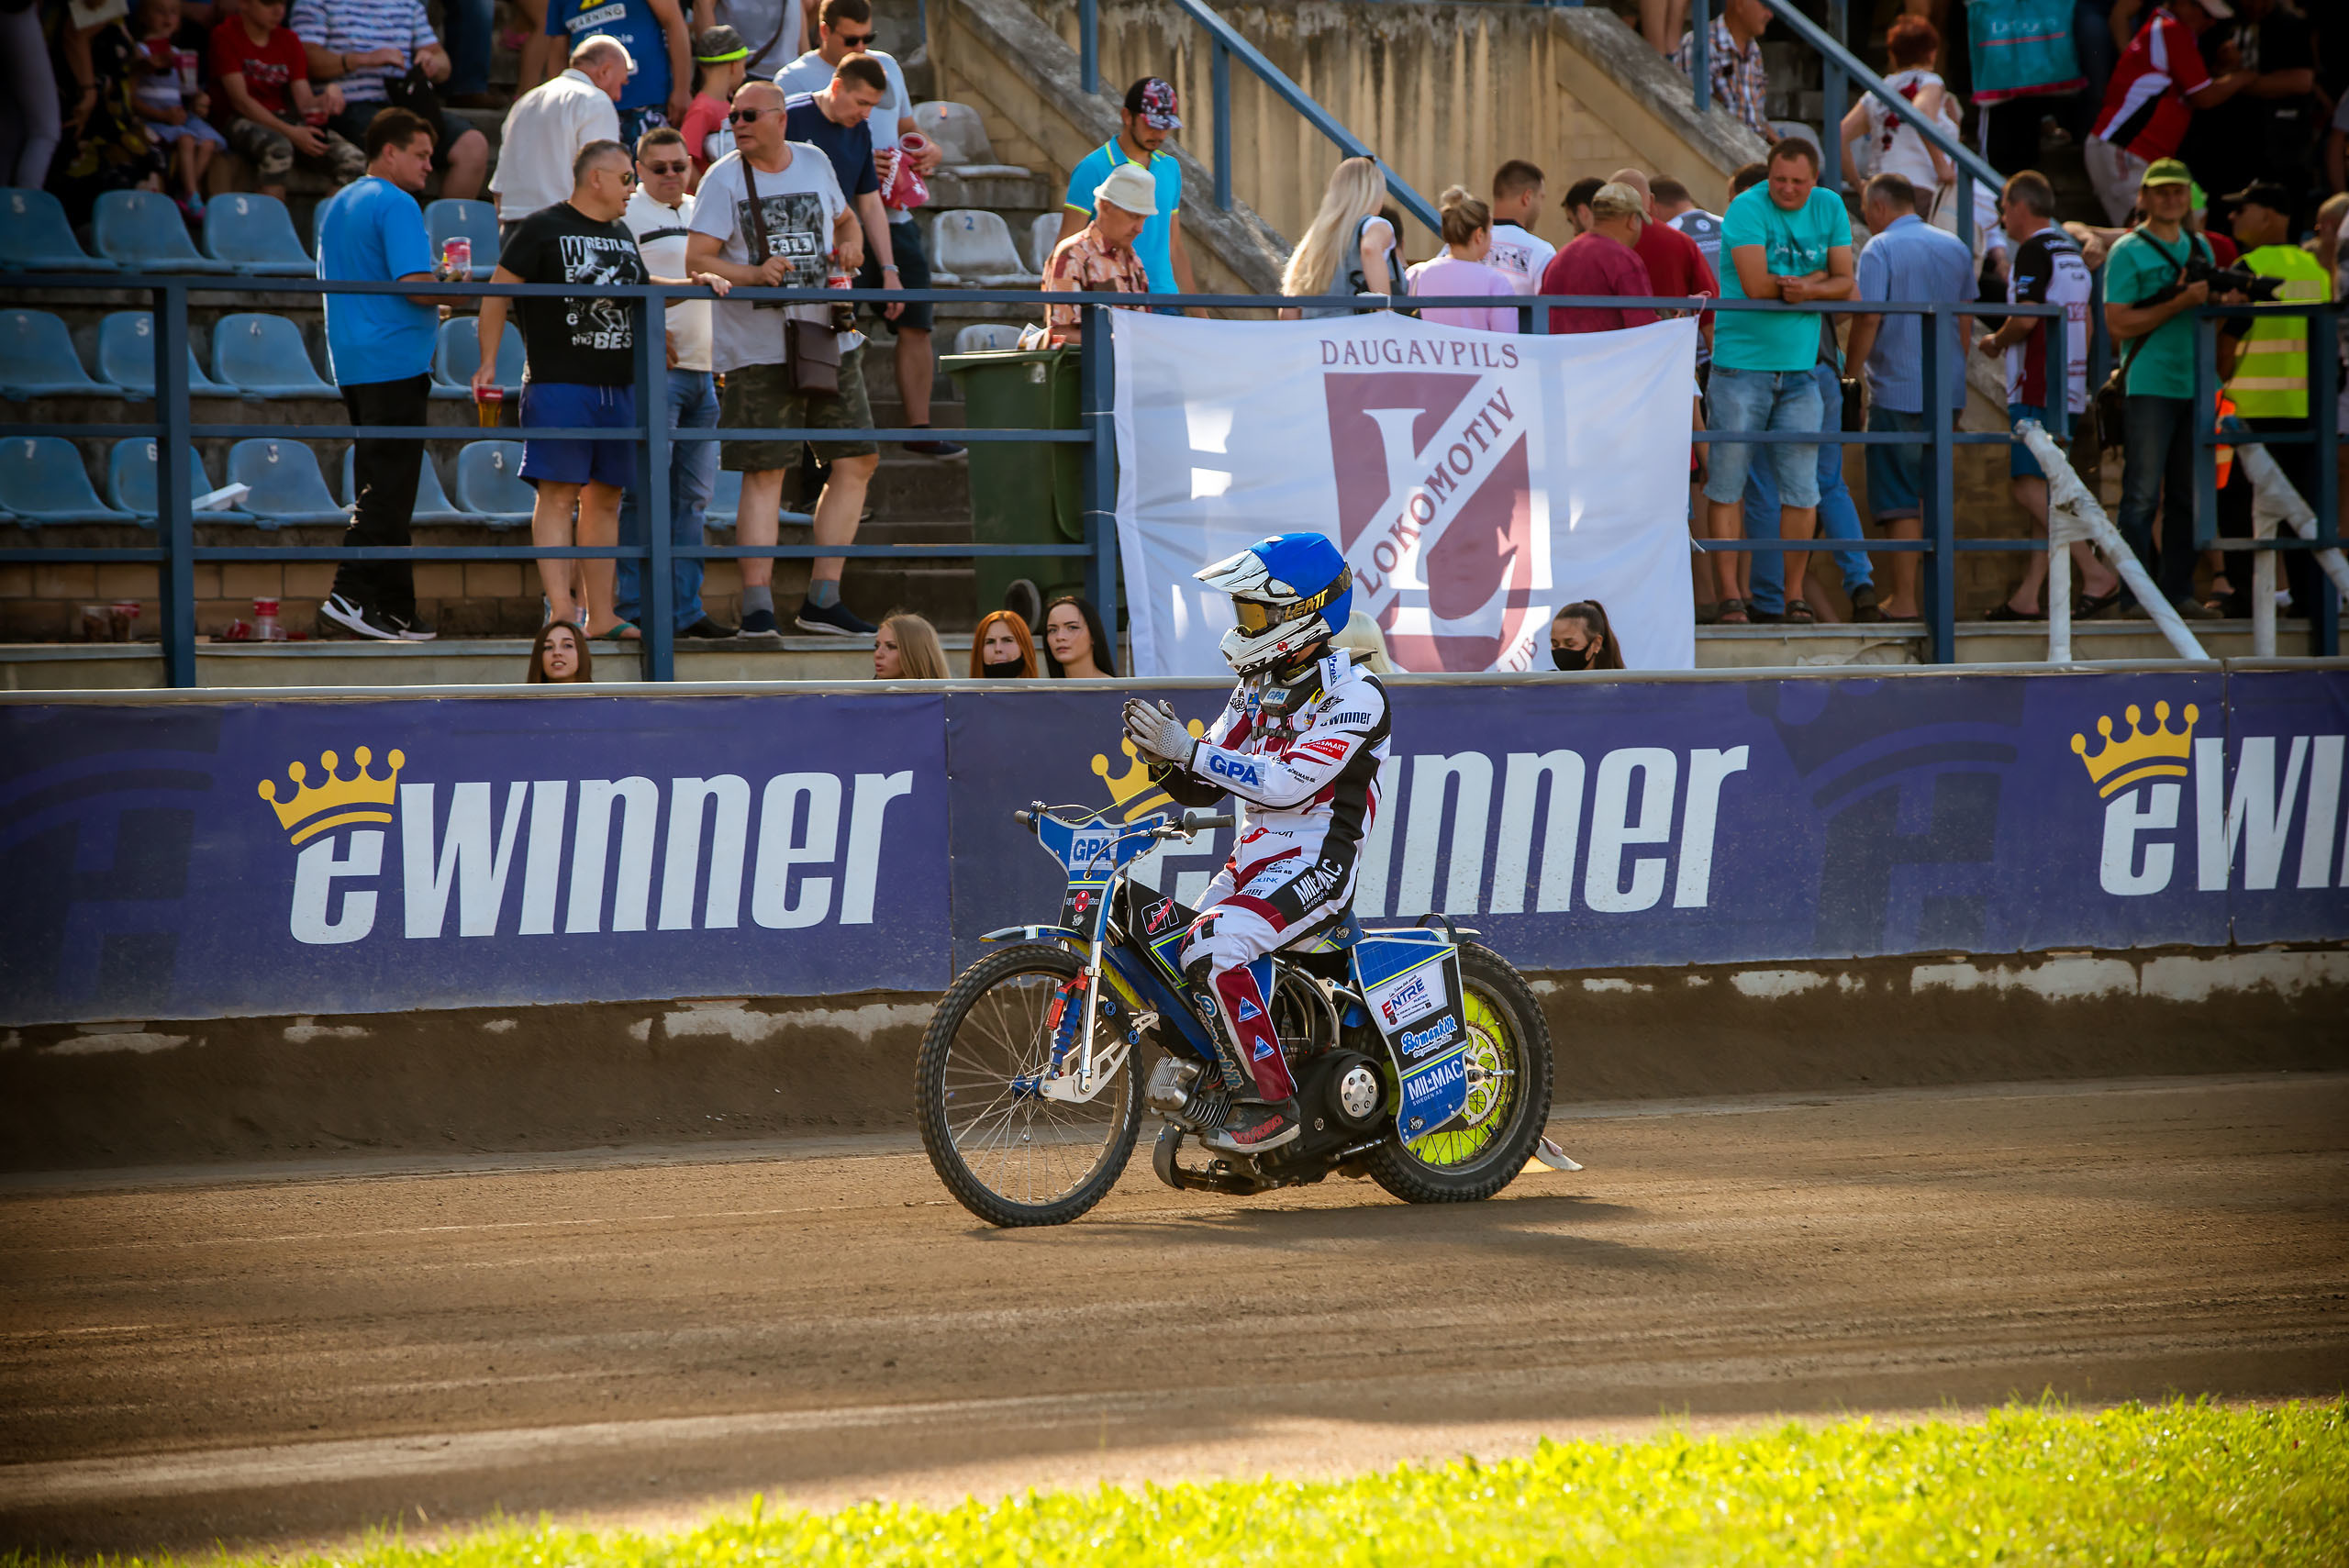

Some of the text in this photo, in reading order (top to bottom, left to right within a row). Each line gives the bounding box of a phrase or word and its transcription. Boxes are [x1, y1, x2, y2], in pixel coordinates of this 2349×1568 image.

[965, 217, 974, 230] 2
[594, 331, 632, 350] BES
[1320, 339, 1519, 368] DAUGAVPILS
[1354, 386, 1515, 598] LOKOMOTIV
[1267, 691, 1286, 701] GPA
[1320, 712, 1372, 727] winner
[1209, 754, 1259, 786] GPA
[1074, 839, 1111, 862] GPA
[1412, 1087, 1443, 1106] SWEDEN AB
